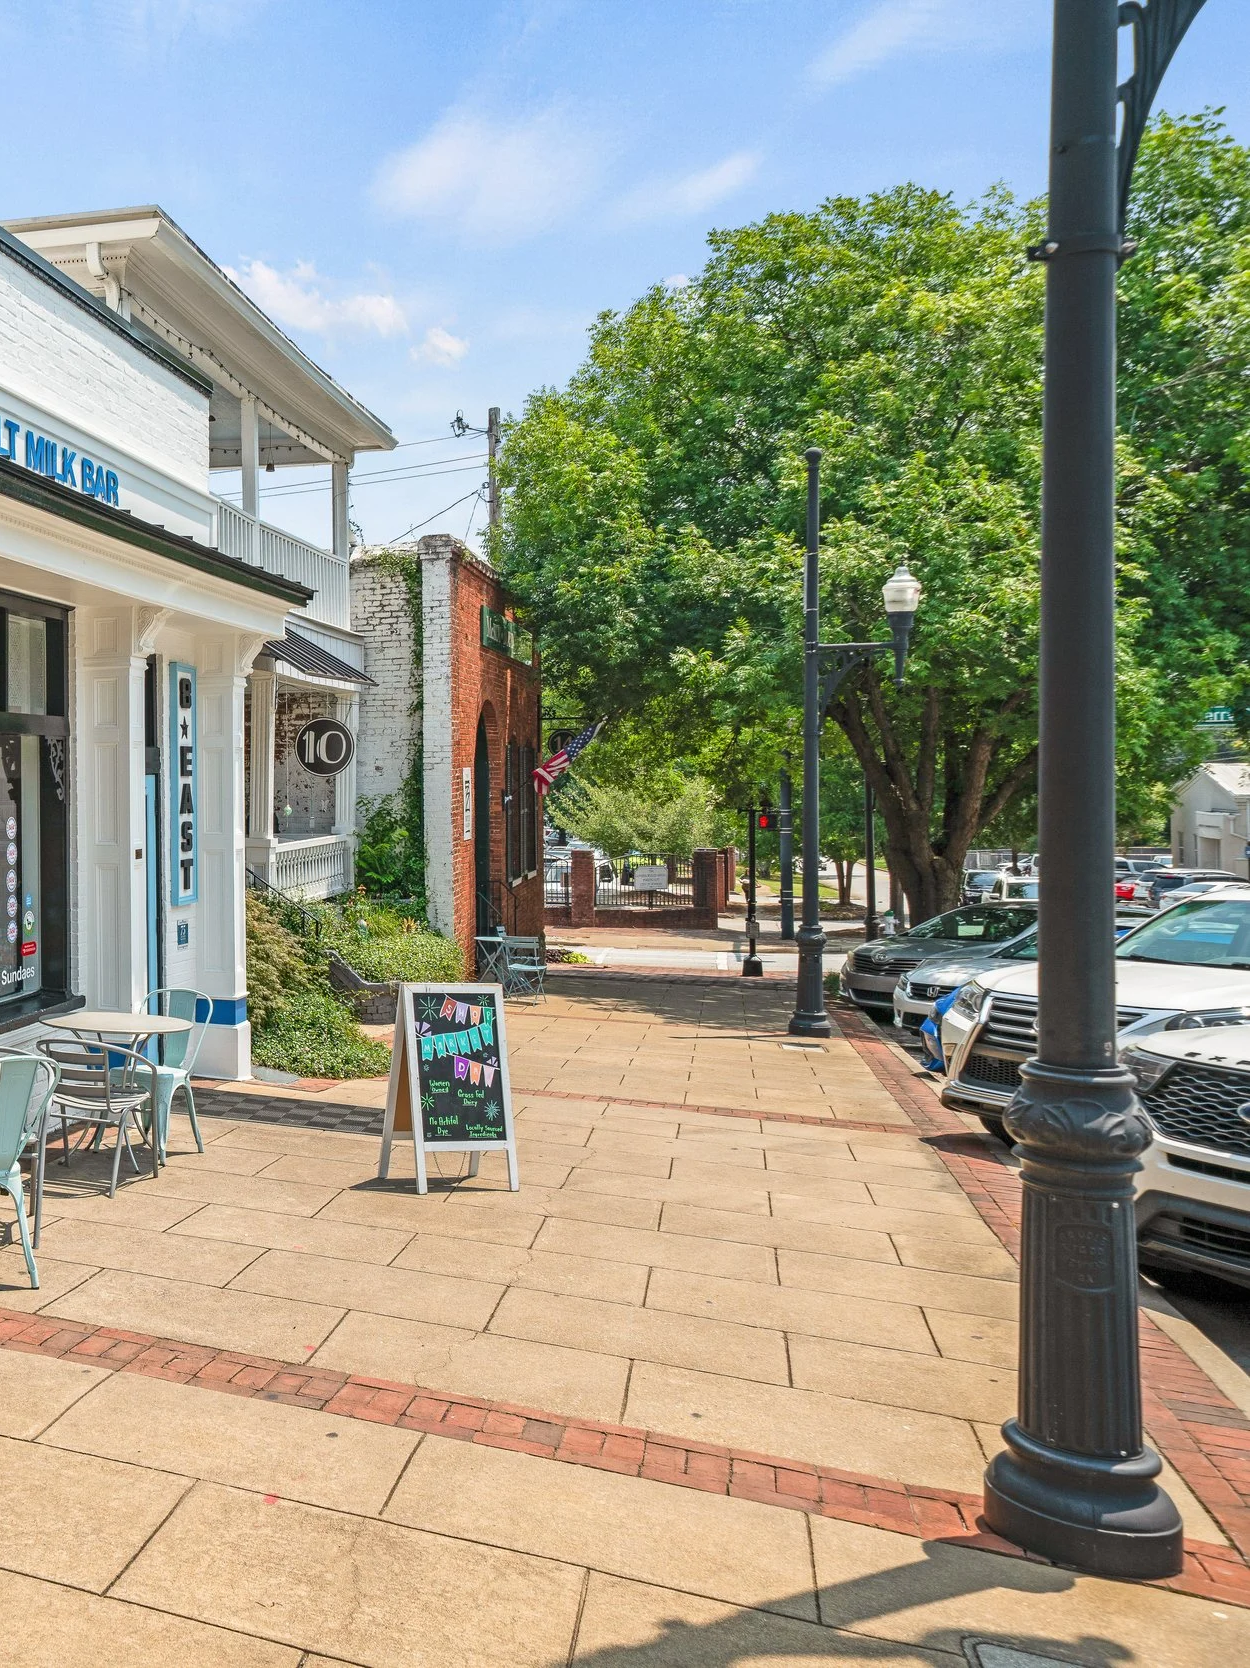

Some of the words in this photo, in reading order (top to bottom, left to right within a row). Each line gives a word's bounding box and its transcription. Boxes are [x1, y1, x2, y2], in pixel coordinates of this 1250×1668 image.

[25, 430, 77, 488] MILK
[81, 457, 119, 507] BAR
[302, 730, 346, 764] 10
[1, 965, 35, 986] Sundaes
[444, 1004, 491, 1021] SHOP
[423, 1029, 492, 1052] MARKET
[457, 1089, 474, 1098] Grass
[437, 1126, 449, 1136] Dye
